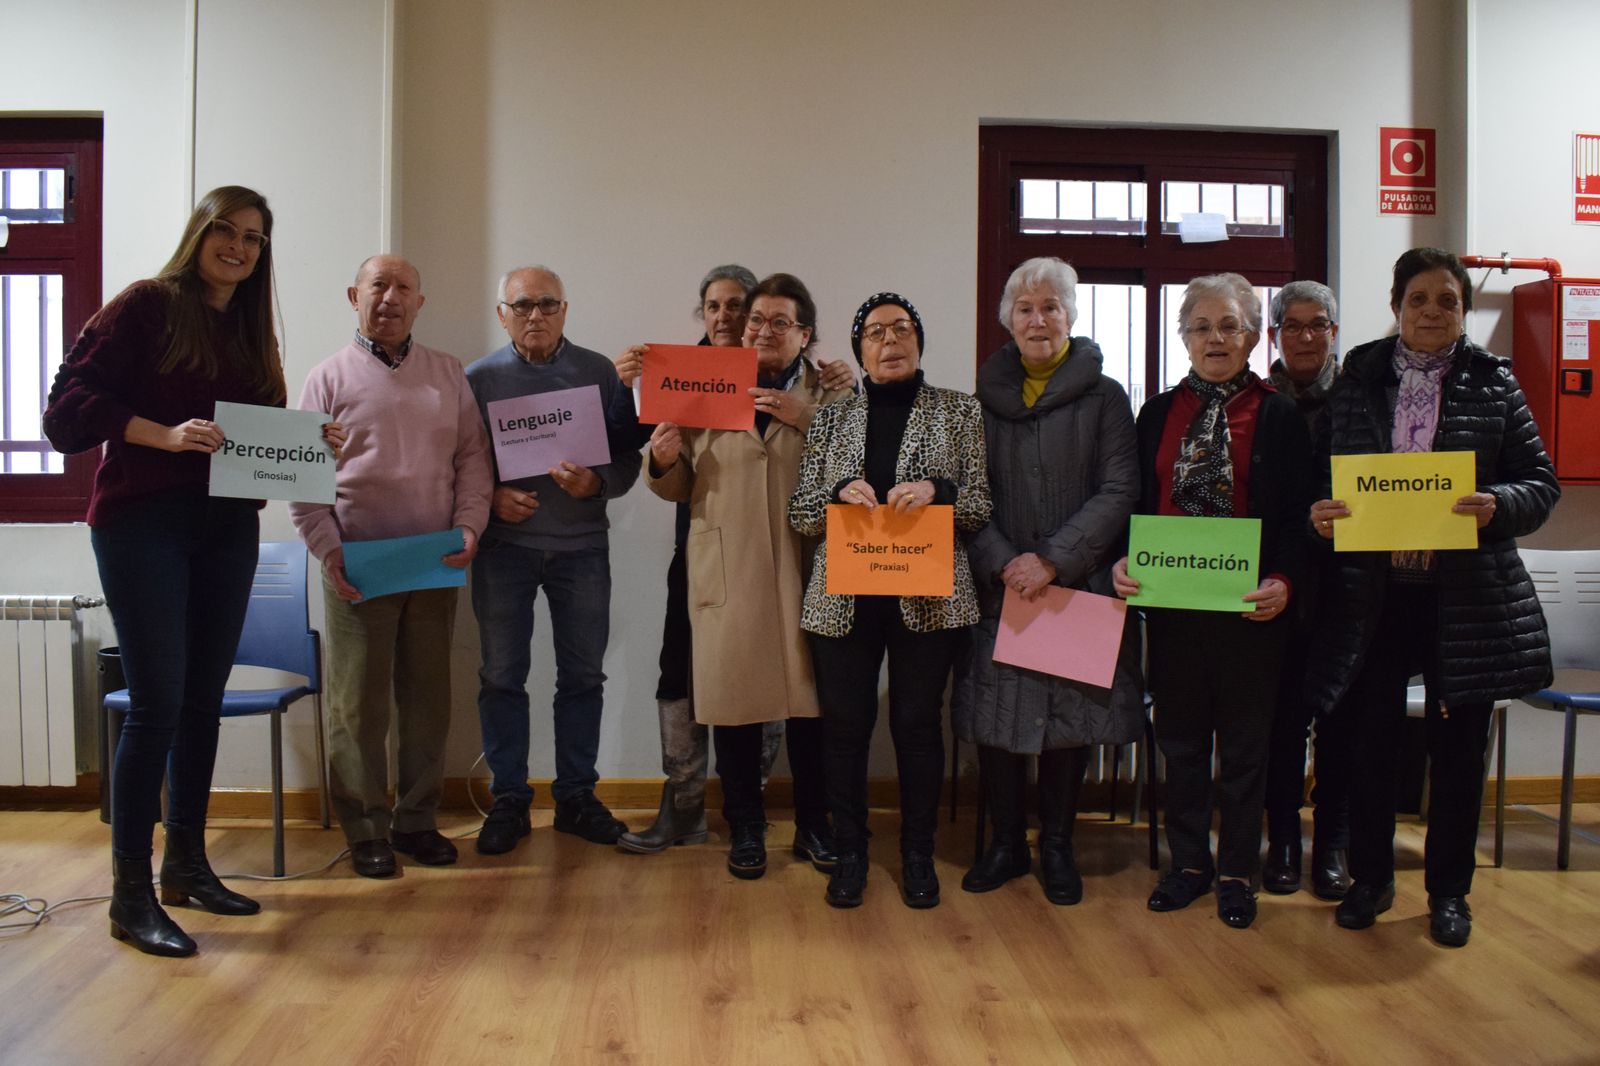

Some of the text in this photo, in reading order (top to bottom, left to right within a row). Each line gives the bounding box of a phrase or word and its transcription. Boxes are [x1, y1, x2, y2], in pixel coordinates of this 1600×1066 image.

[1384, 193, 1431, 202] PULSADOR
[1381, 202, 1434, 211] DE ALARMA
[1577, 204, 1600, 214] MAN
[660, 376, 736, 394] Atención
[498, 408, 573, 431] Lenguaje
[501, 437, 524, 446] (Lectura
[529, 431, 557, 441] Escritura)
[223, 438, 326, 464] Percepción
[253, 469, 297, 483] (Gnosias)
[1356, 473, 1452, 492] Memoria
[846, 542, 933, 554] “Saber hacer”
[870, 562, 909, 573] (Praxias)
[1136, 550, 1249, 571] Orientación
